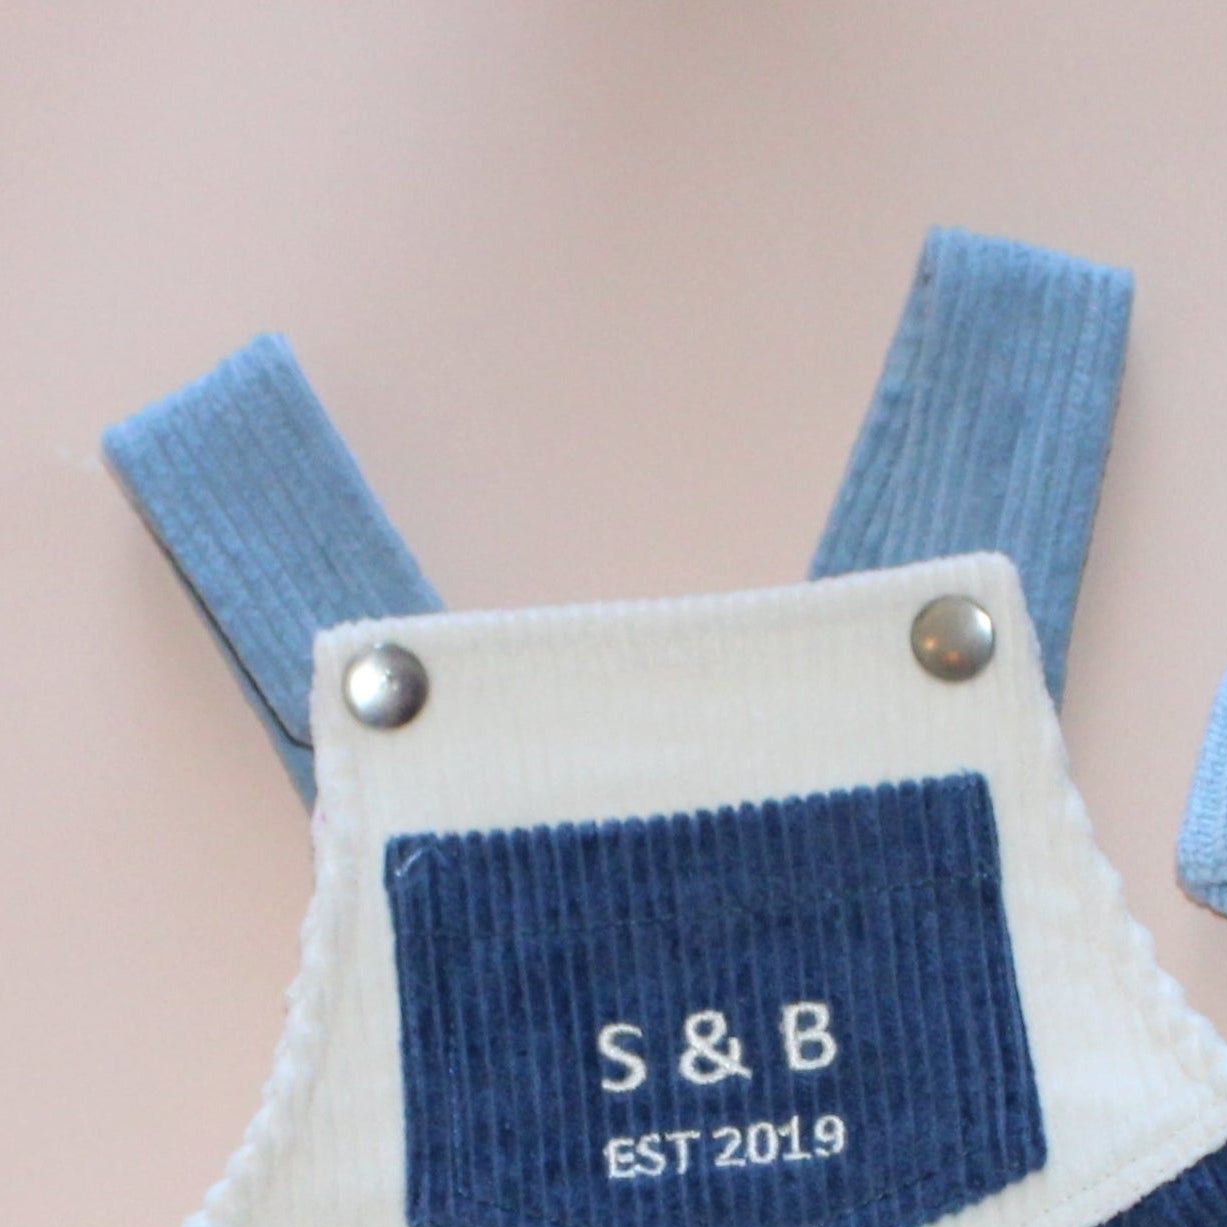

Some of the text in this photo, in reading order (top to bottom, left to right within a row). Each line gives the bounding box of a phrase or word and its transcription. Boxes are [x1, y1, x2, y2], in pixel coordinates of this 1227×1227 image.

[597, 1000, 838, 1094] S & B
[602, 1113, 847, 1180] EST 2019
